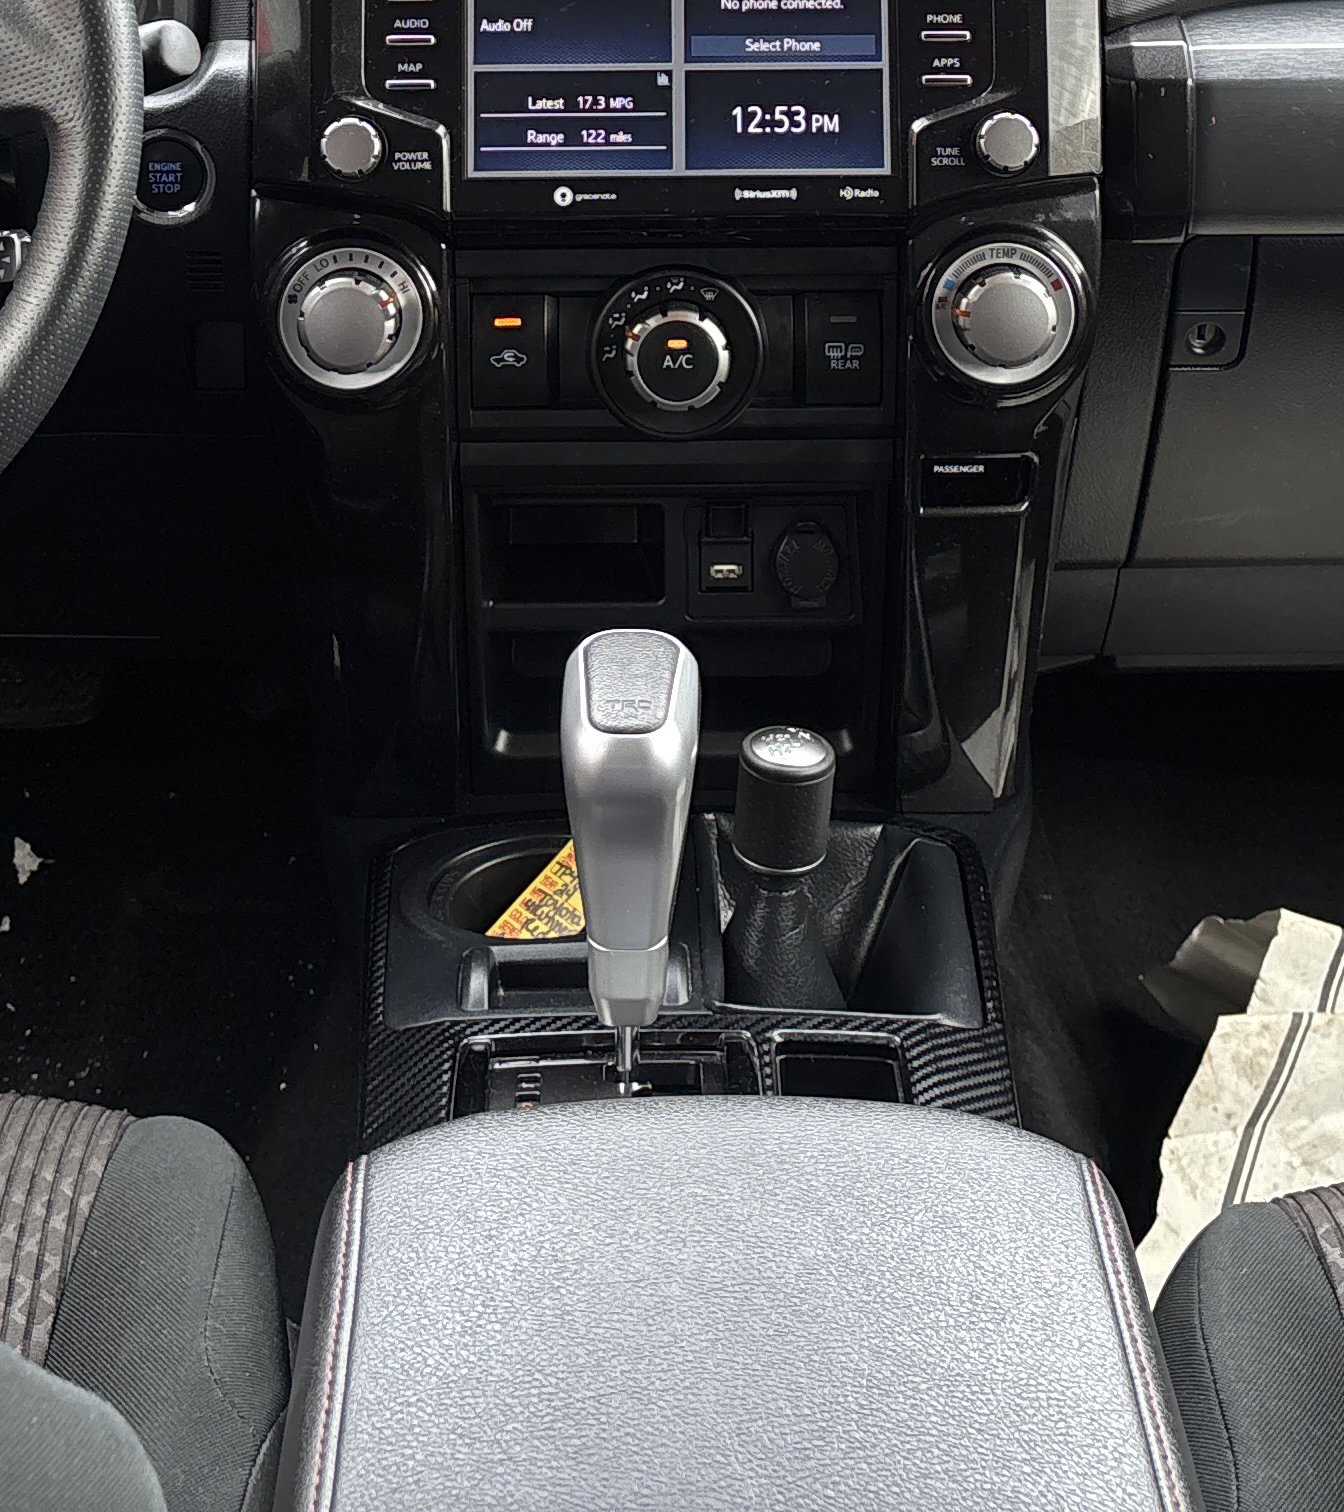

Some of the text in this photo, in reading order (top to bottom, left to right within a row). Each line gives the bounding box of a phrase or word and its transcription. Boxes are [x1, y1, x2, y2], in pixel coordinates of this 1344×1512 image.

[393, 19, 429, 29] AUDIO
[926, 14, 963, 24] PHONE
[479, 18, 535, 33] Audio Off
[745, 38, 821, 52] Select Phone
[397, 63, 423, 73] MAP
[932, 58, 961, 68] APPS
[527, 95, 634, 110] Latest 17.3 MPG
[731, 105, 840, 134] 12:53 PM
[526, 129, 633, 144] Range 122 miles
[394, 152, 429, 161] POWER
[936, 147, 961, 157] TUNE
[148, 162, 182, 172] ENGINE
[392, 161, 432, 170] VOLUME
[931, 156, 966, 167] SCROLL
[148, 172, 183, 183] START
[151, 183, 182, 194] STOP
[854, 189, 880, 198] Radio
[988, 247, 1018, 260] TEMP
[315, 257, 330, 273] LO
[292, 271, 311, 293] OFF
[397, 280, 411, 295] HI
[662, 354, 694, 369] A/C
[830, 359, 860, 370] REAR
[933, 464, 985, 473] PASSENGER
